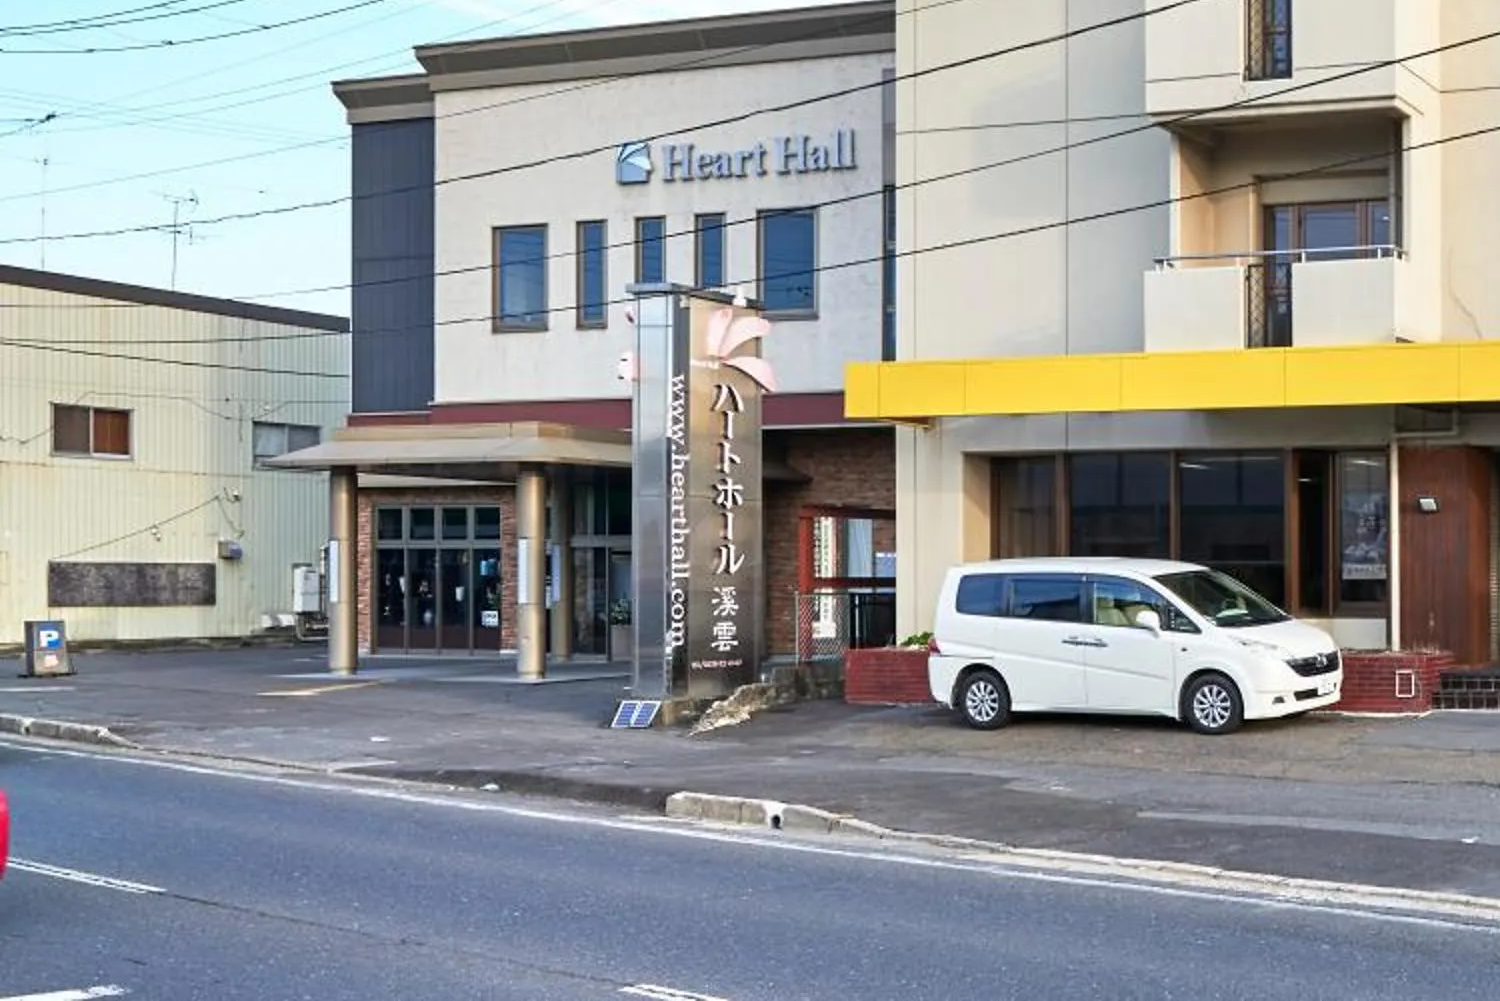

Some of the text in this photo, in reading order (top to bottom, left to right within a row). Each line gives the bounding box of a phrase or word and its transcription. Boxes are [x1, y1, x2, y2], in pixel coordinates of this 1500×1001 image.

[662, 126, 858, 183] Heart Hall
[670, 373, 691, 649] www.hearthall.com
[712, 383, 745, 576] ハートホール
[39, 630, 59, 648] P
